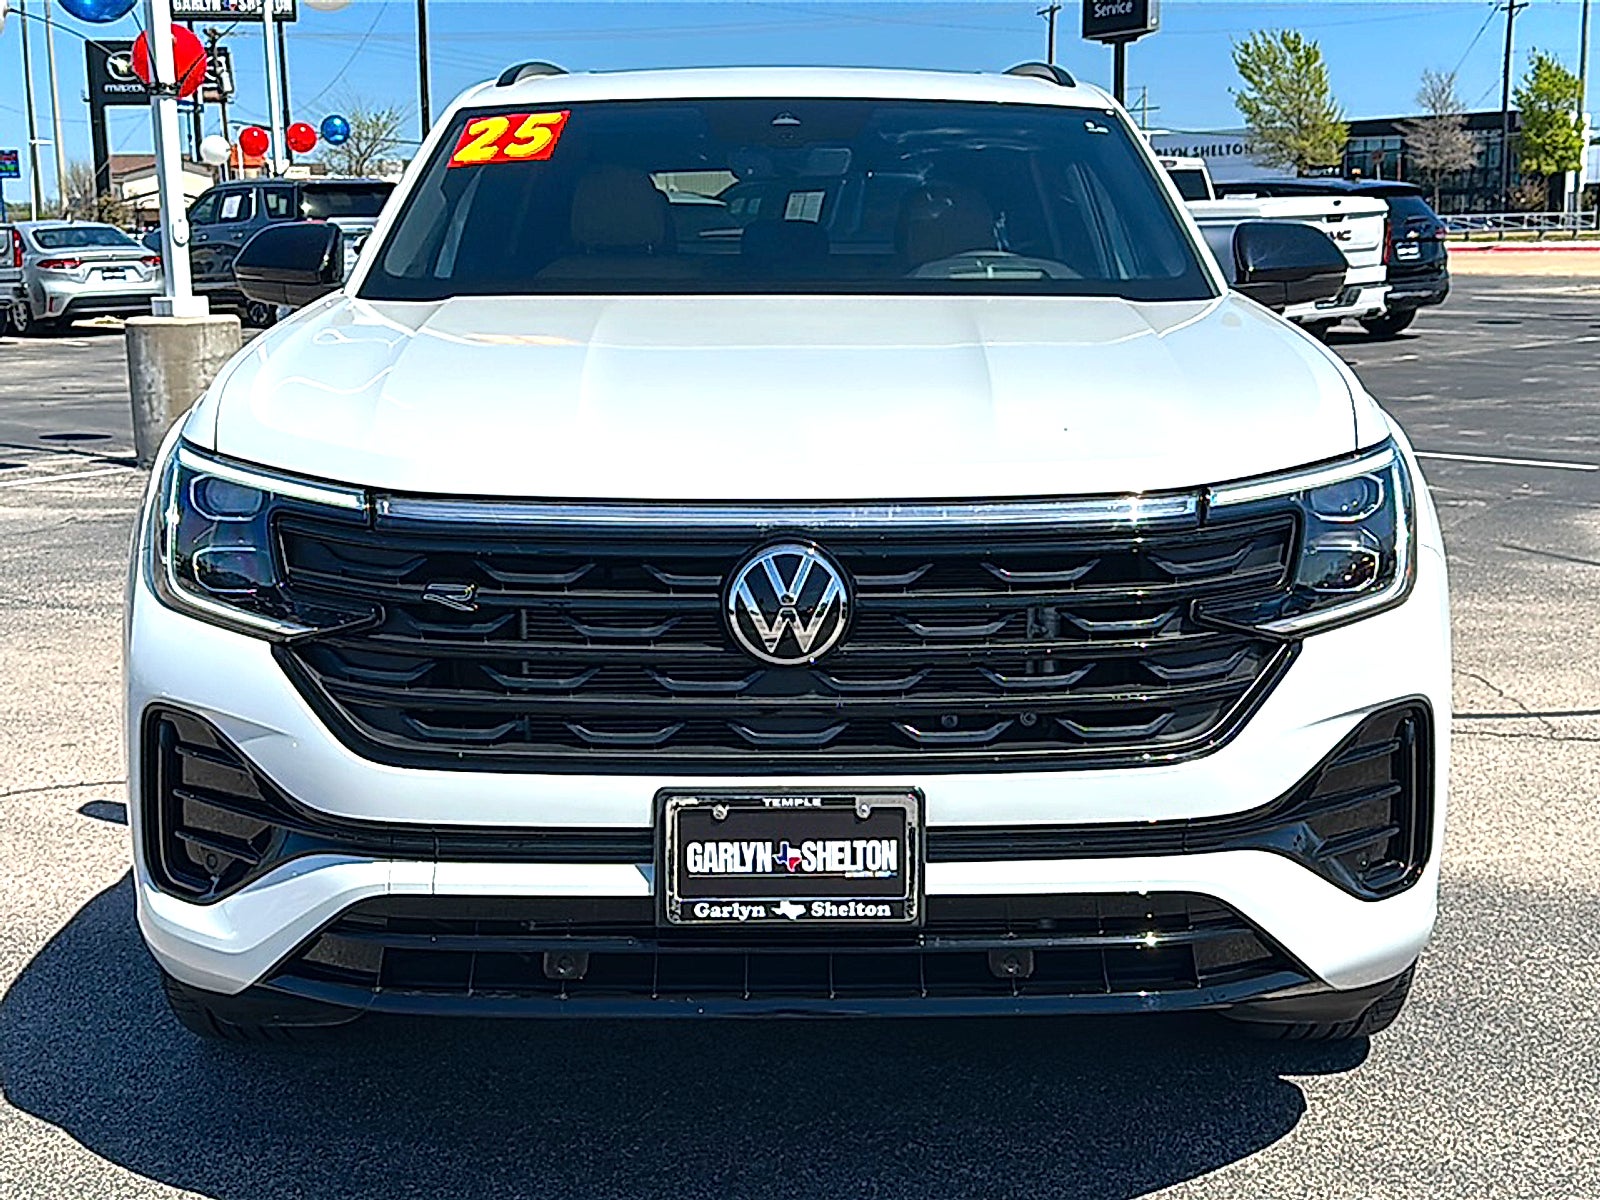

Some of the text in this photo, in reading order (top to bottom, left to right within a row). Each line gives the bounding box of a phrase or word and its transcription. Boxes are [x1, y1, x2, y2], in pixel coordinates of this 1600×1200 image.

[1094, 1, 1133, 18] Service
[453, 112, 563, 163] 25
[732, 547, 844, 661] VW
[762, 797, 822, 807] TEMPLE
[687, 839, 898, 873] GARLYN SHELTON
[693, 901, 892, 921] Garlyn Shelton
